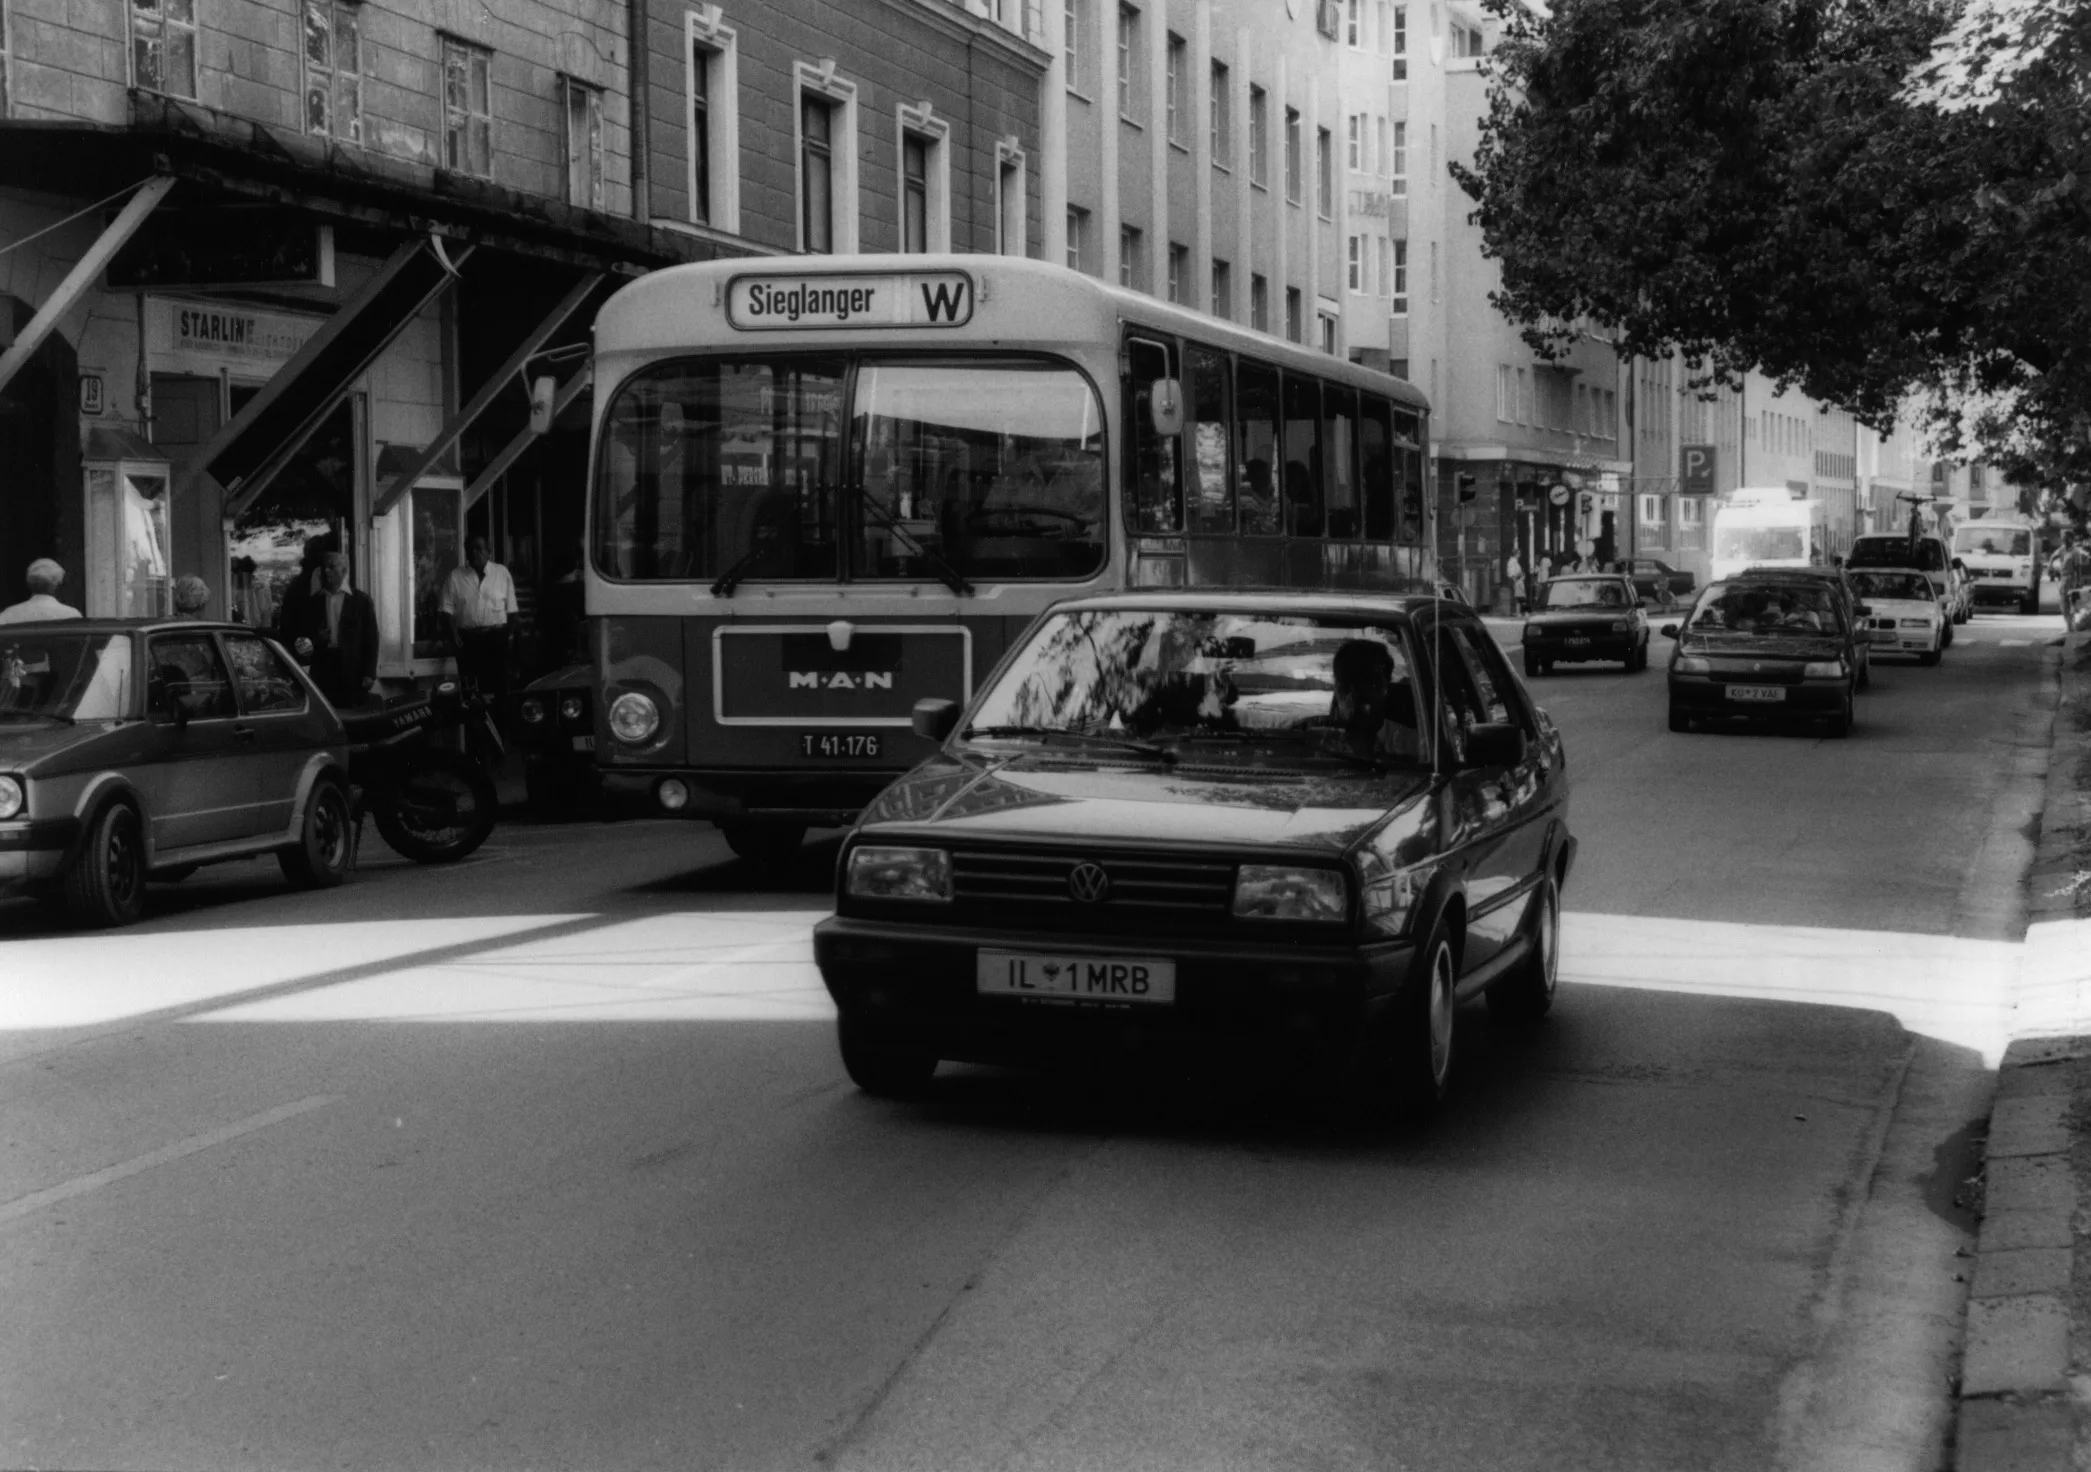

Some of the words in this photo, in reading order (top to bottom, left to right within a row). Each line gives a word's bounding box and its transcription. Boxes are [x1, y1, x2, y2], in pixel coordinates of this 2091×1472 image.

[748, 283, 875, 321] Sieglanger
[921, 282, 965, 322] W
[181, 310, 255, 344] STARLINE
[86, 379, 98, 401] 19
[1687, 450, 1706, 478] P
[803, 735, 814, 755] T
[1009, 959, 1036, 989] IL
